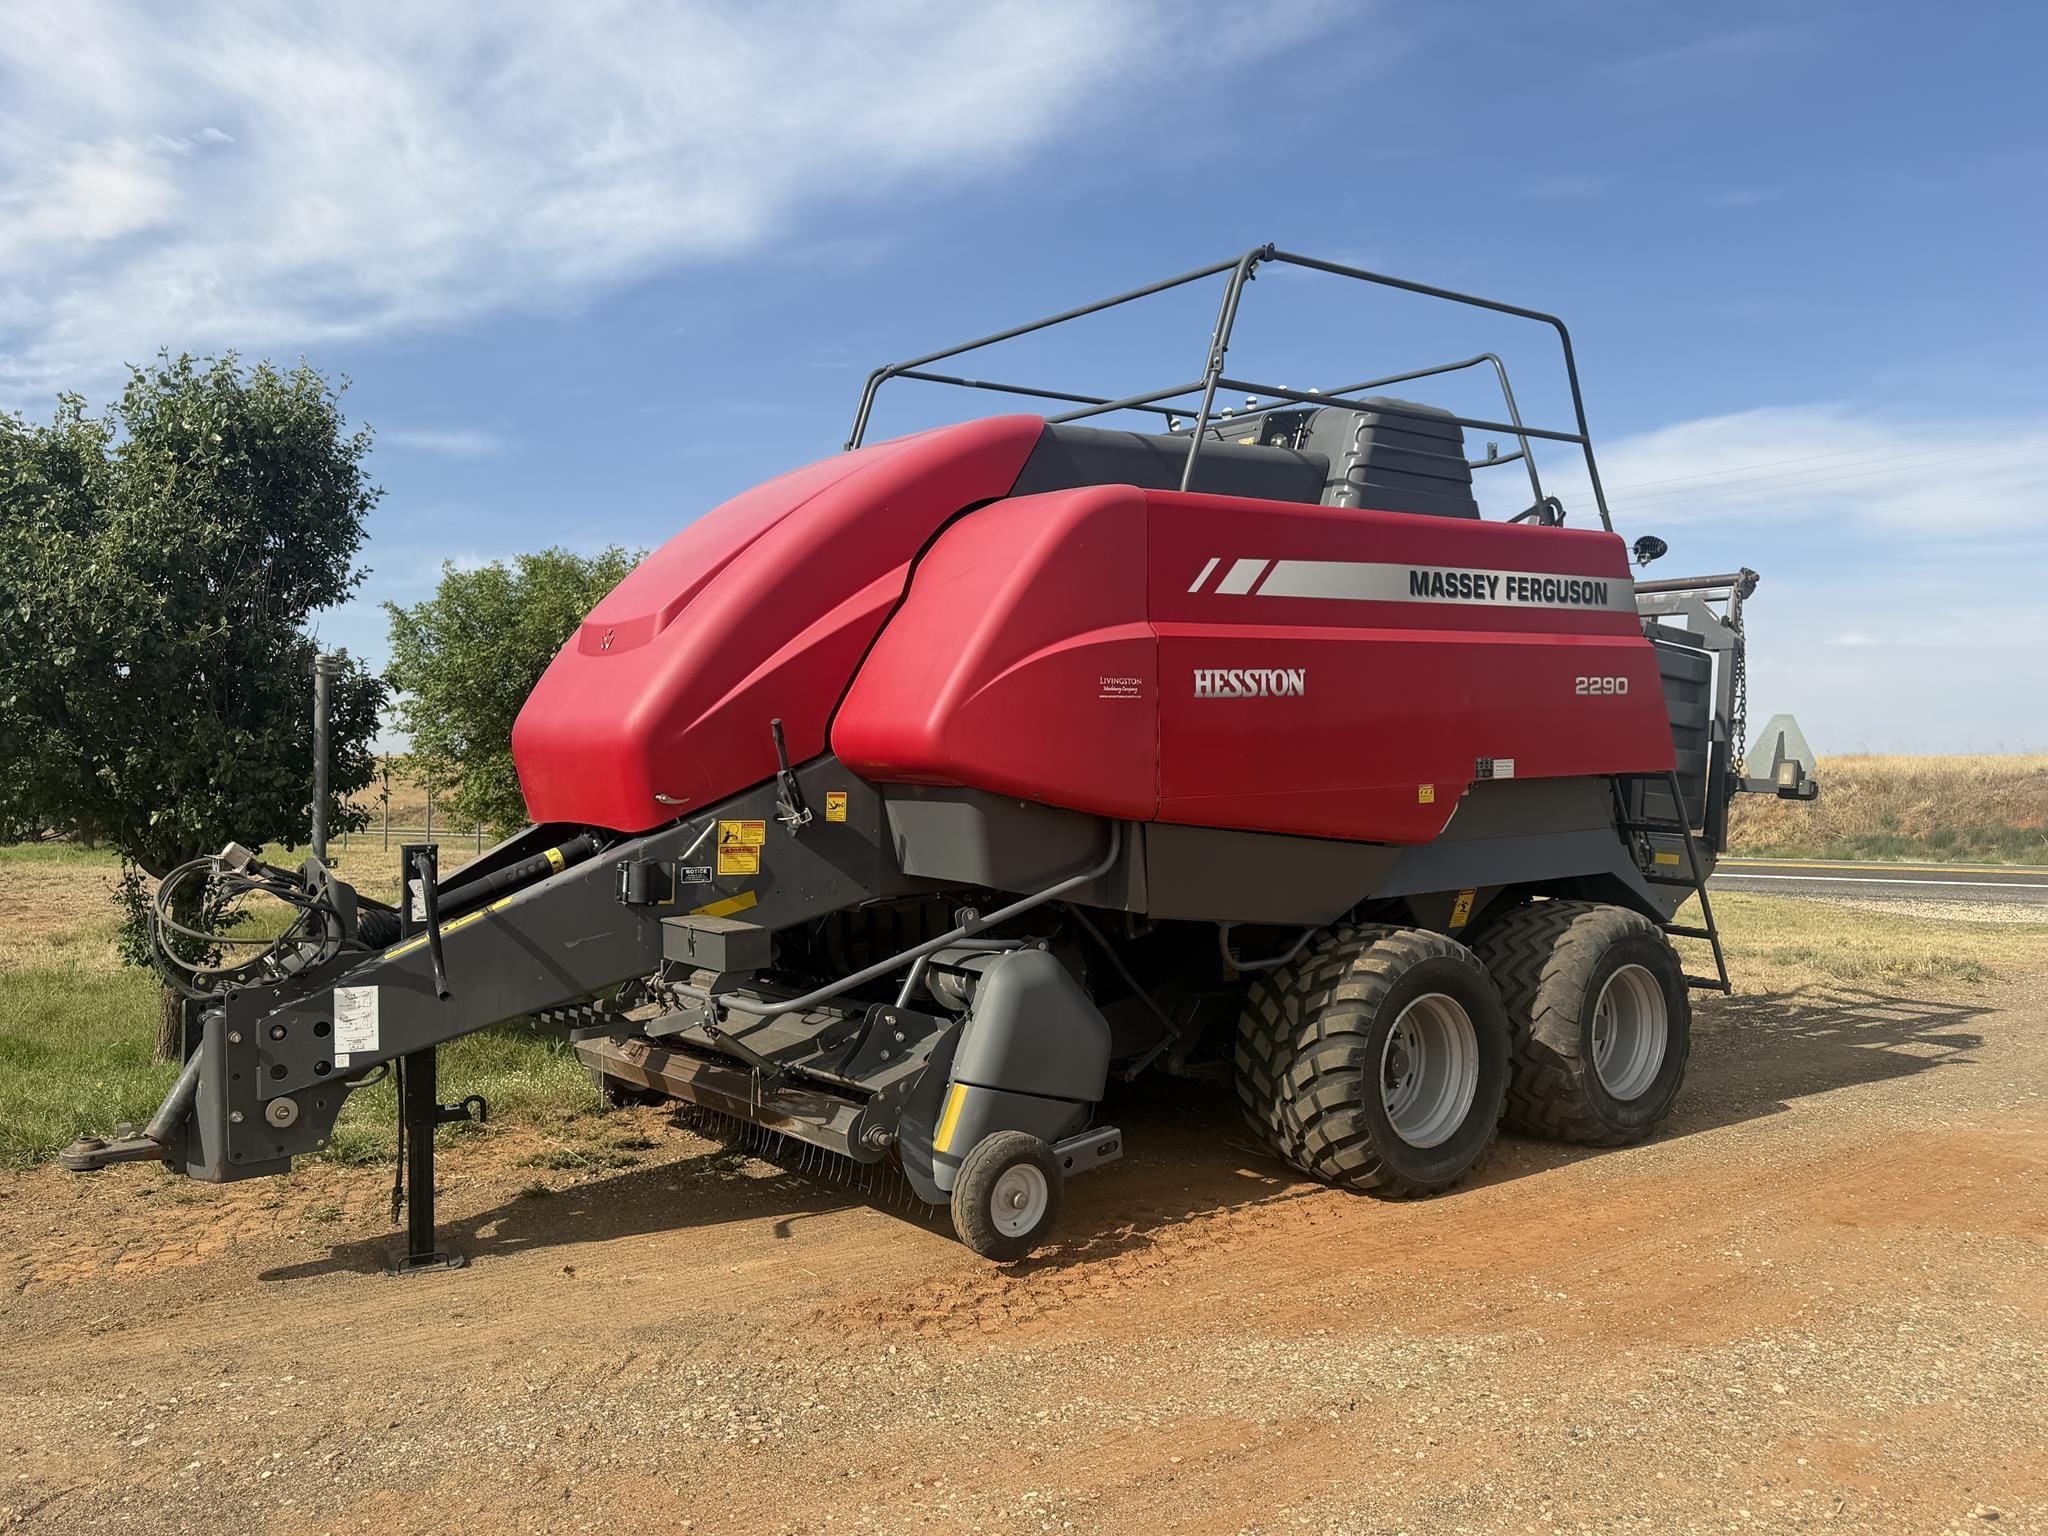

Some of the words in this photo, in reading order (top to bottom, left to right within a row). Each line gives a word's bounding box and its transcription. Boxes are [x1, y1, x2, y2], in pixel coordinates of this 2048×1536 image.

[1410, 570, 1499, 600] MASSEY
[1506, 576, 1608, 605] FERGUSON
[1100, 677, 1142, 685] LIVINGSTON
[1193, 669, 1305, 698] HESSTON
[1576, 677, 1628, 695] 2290
